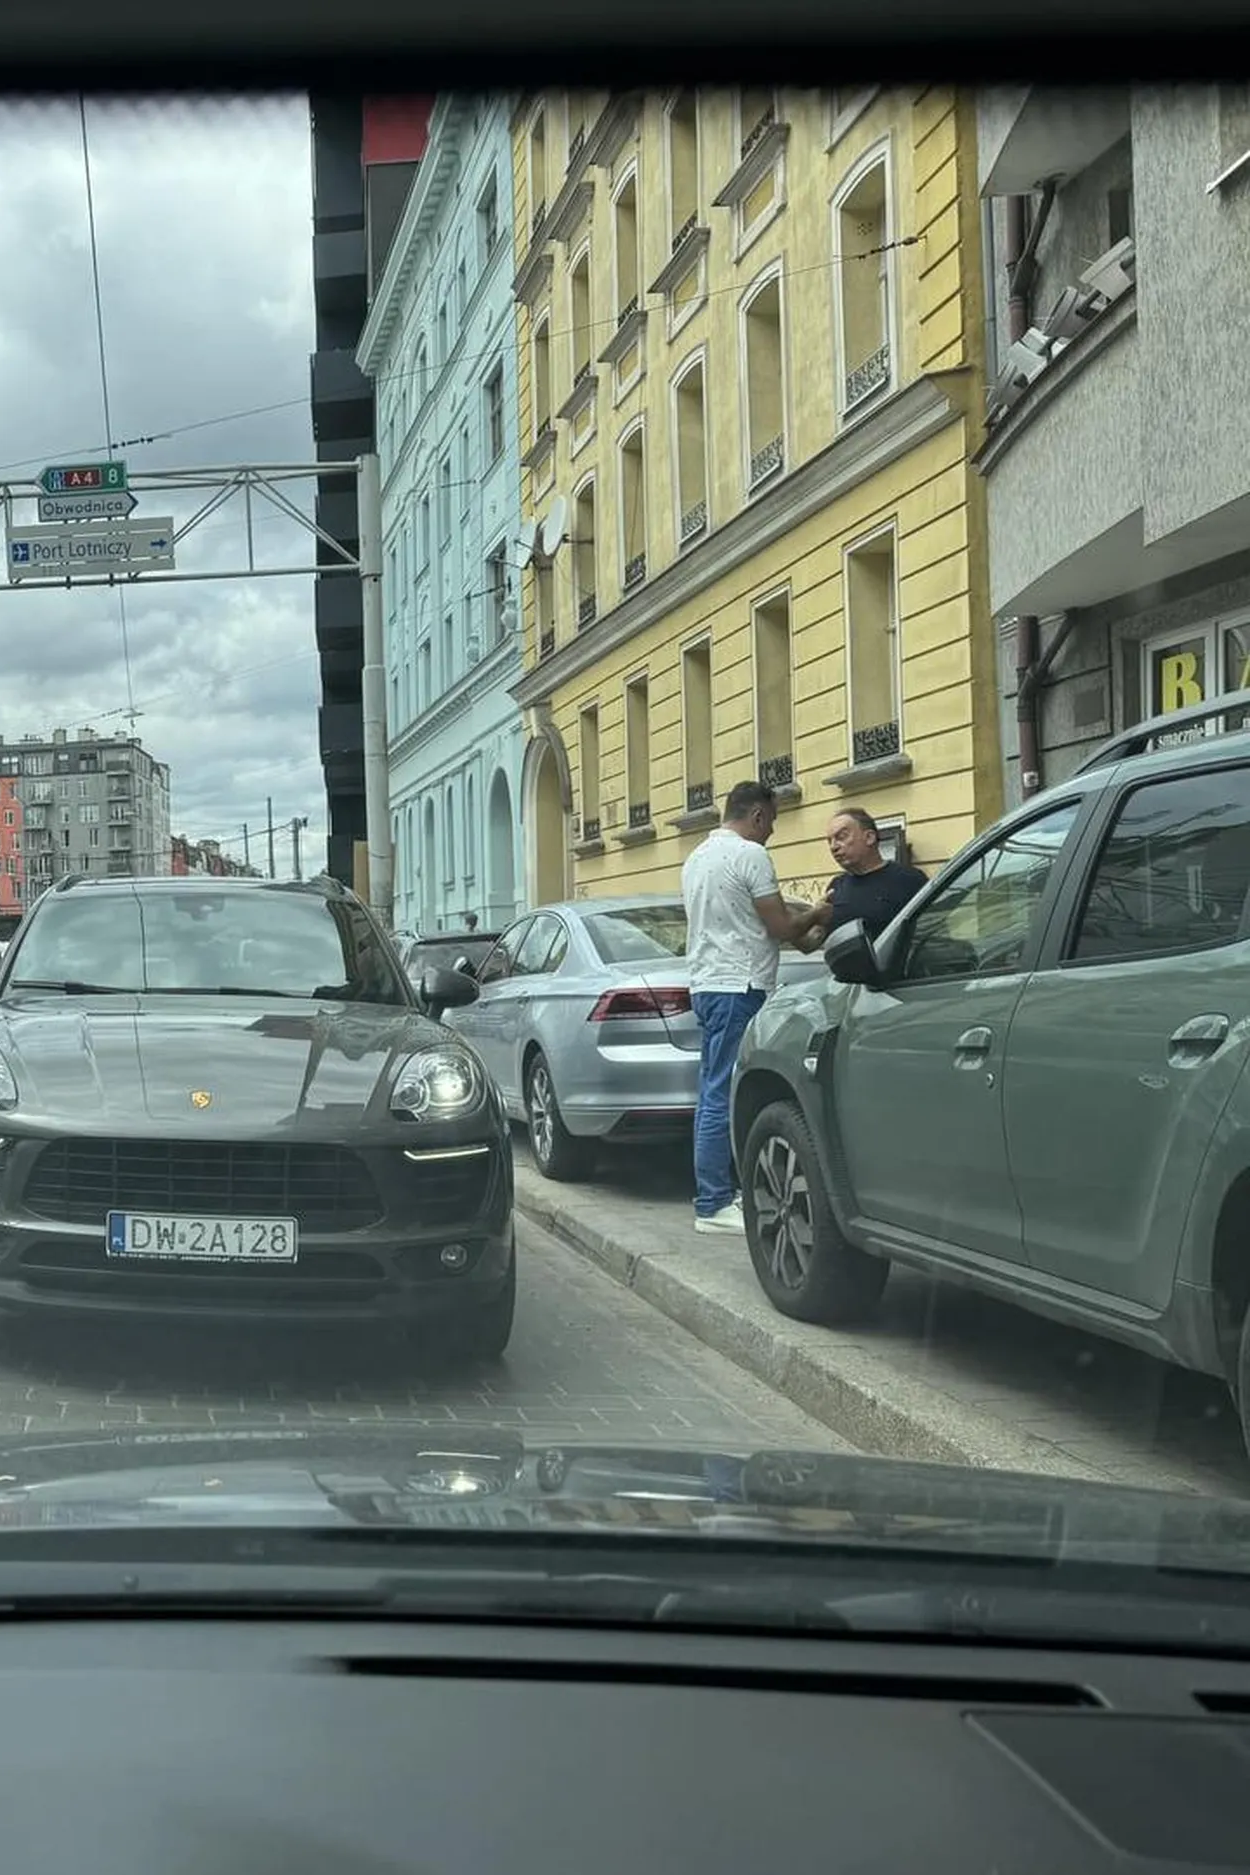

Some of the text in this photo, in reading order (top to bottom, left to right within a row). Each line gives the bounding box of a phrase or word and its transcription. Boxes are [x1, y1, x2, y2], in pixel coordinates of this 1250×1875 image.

[70, 469, 118, 486] A4 8
[42, 501, 123, 516] Obwodnica
[33, 540, 133, 559] Port Lotniczy
